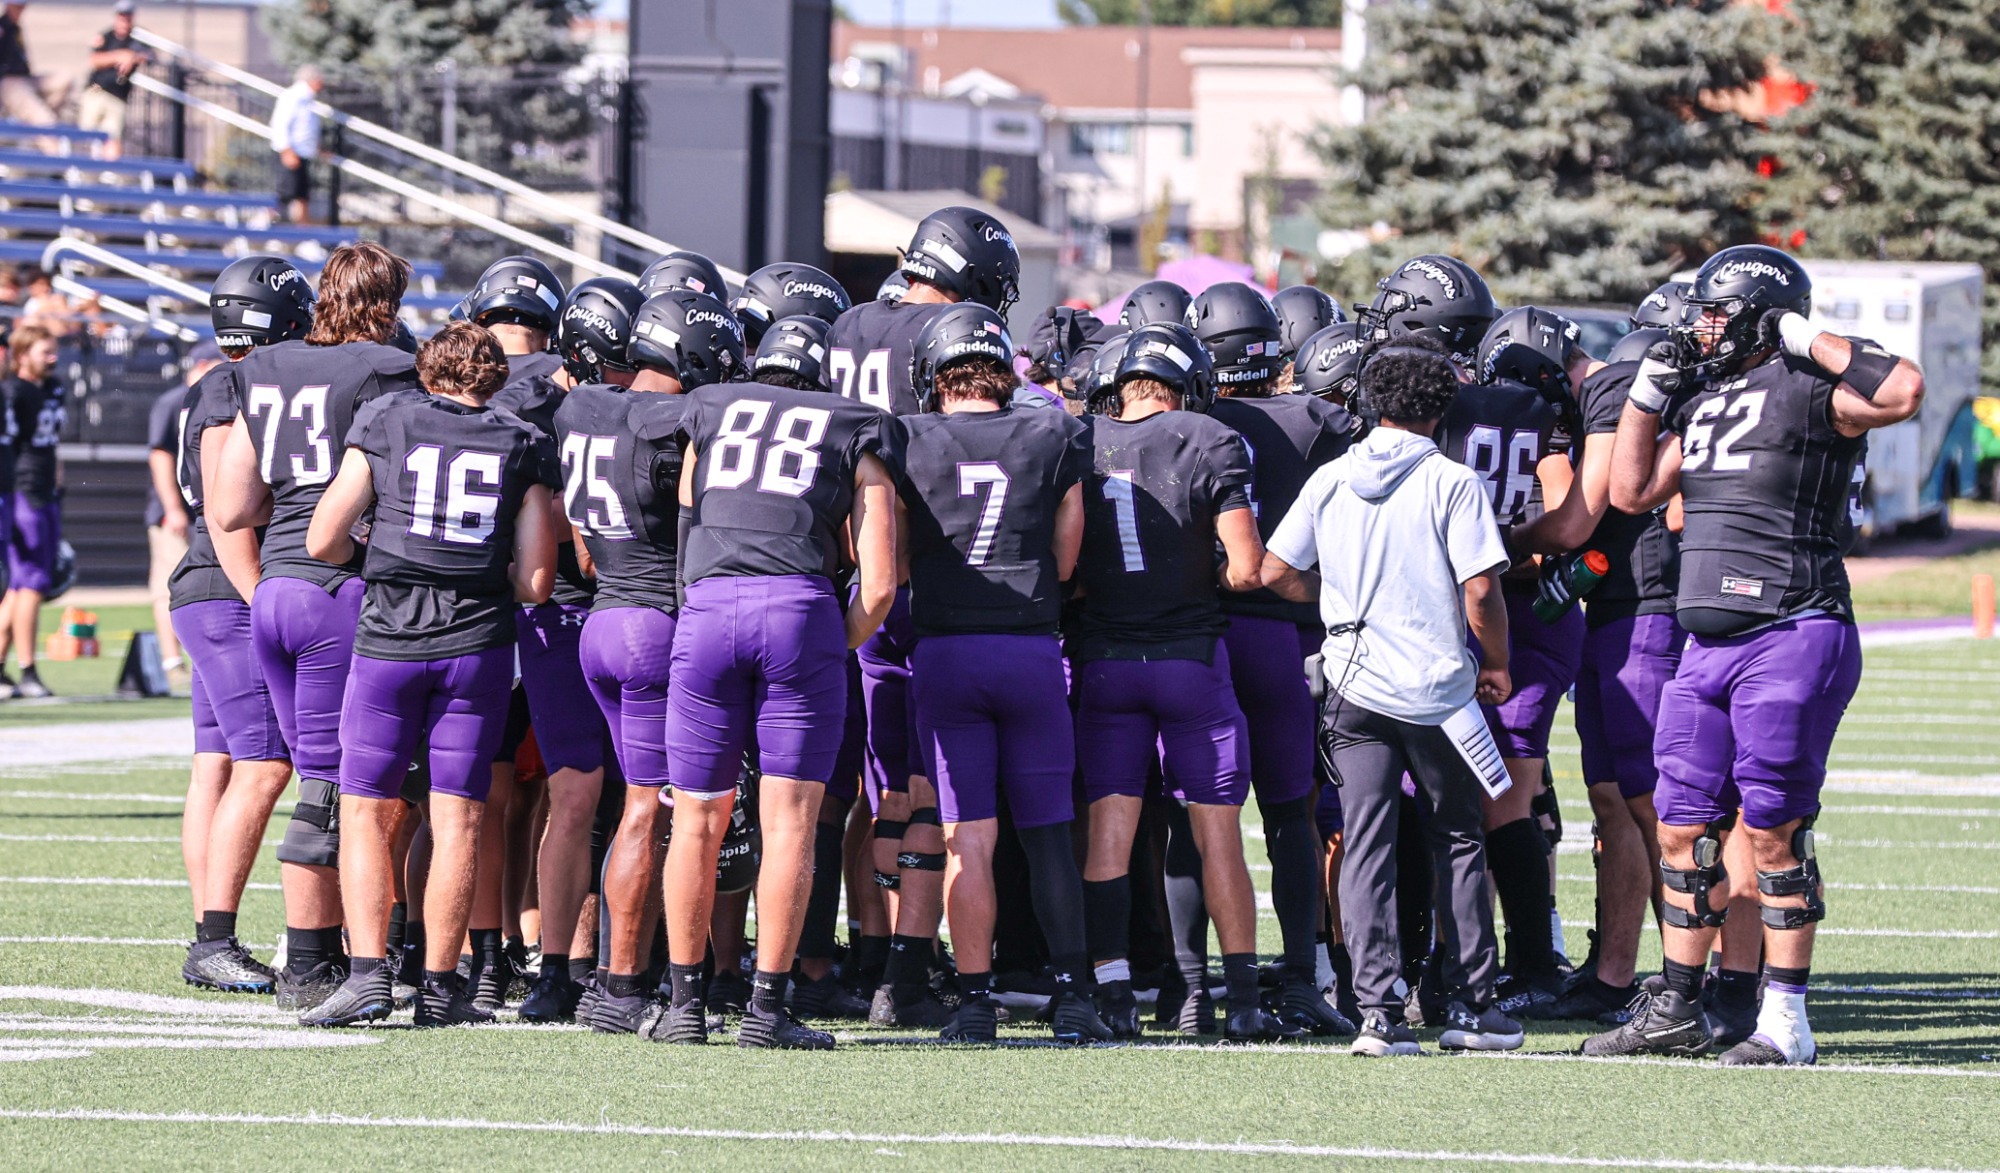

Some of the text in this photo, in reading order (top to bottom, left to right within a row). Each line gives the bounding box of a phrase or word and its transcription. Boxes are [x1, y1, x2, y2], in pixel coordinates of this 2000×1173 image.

[1404, 260, 1456, 300] Cougars
[1719, 261, 1789, 286] Cougars
[783, 281, 846, 309] Cougars
[565, 304, 619, 341] Cougars
[686, 308, 742, 342] Cougars
[973, 329, 988, 338] USF
[755, 354, 801, 371] Riddell
[955, 341, 1005, 359] Riddell
[1217, 368, 1268, 383] Riddell
[249, 384, 335, 487] 73
[704, 398, 835, 497] 88
[1680, 389, 1769, 473] 62
[1463, 424, 1540, 525] 86
[403, 443, 503, 546] 16
[956, 461, 1012, 567] 7
[1102, 469, 1147, 573] 1
